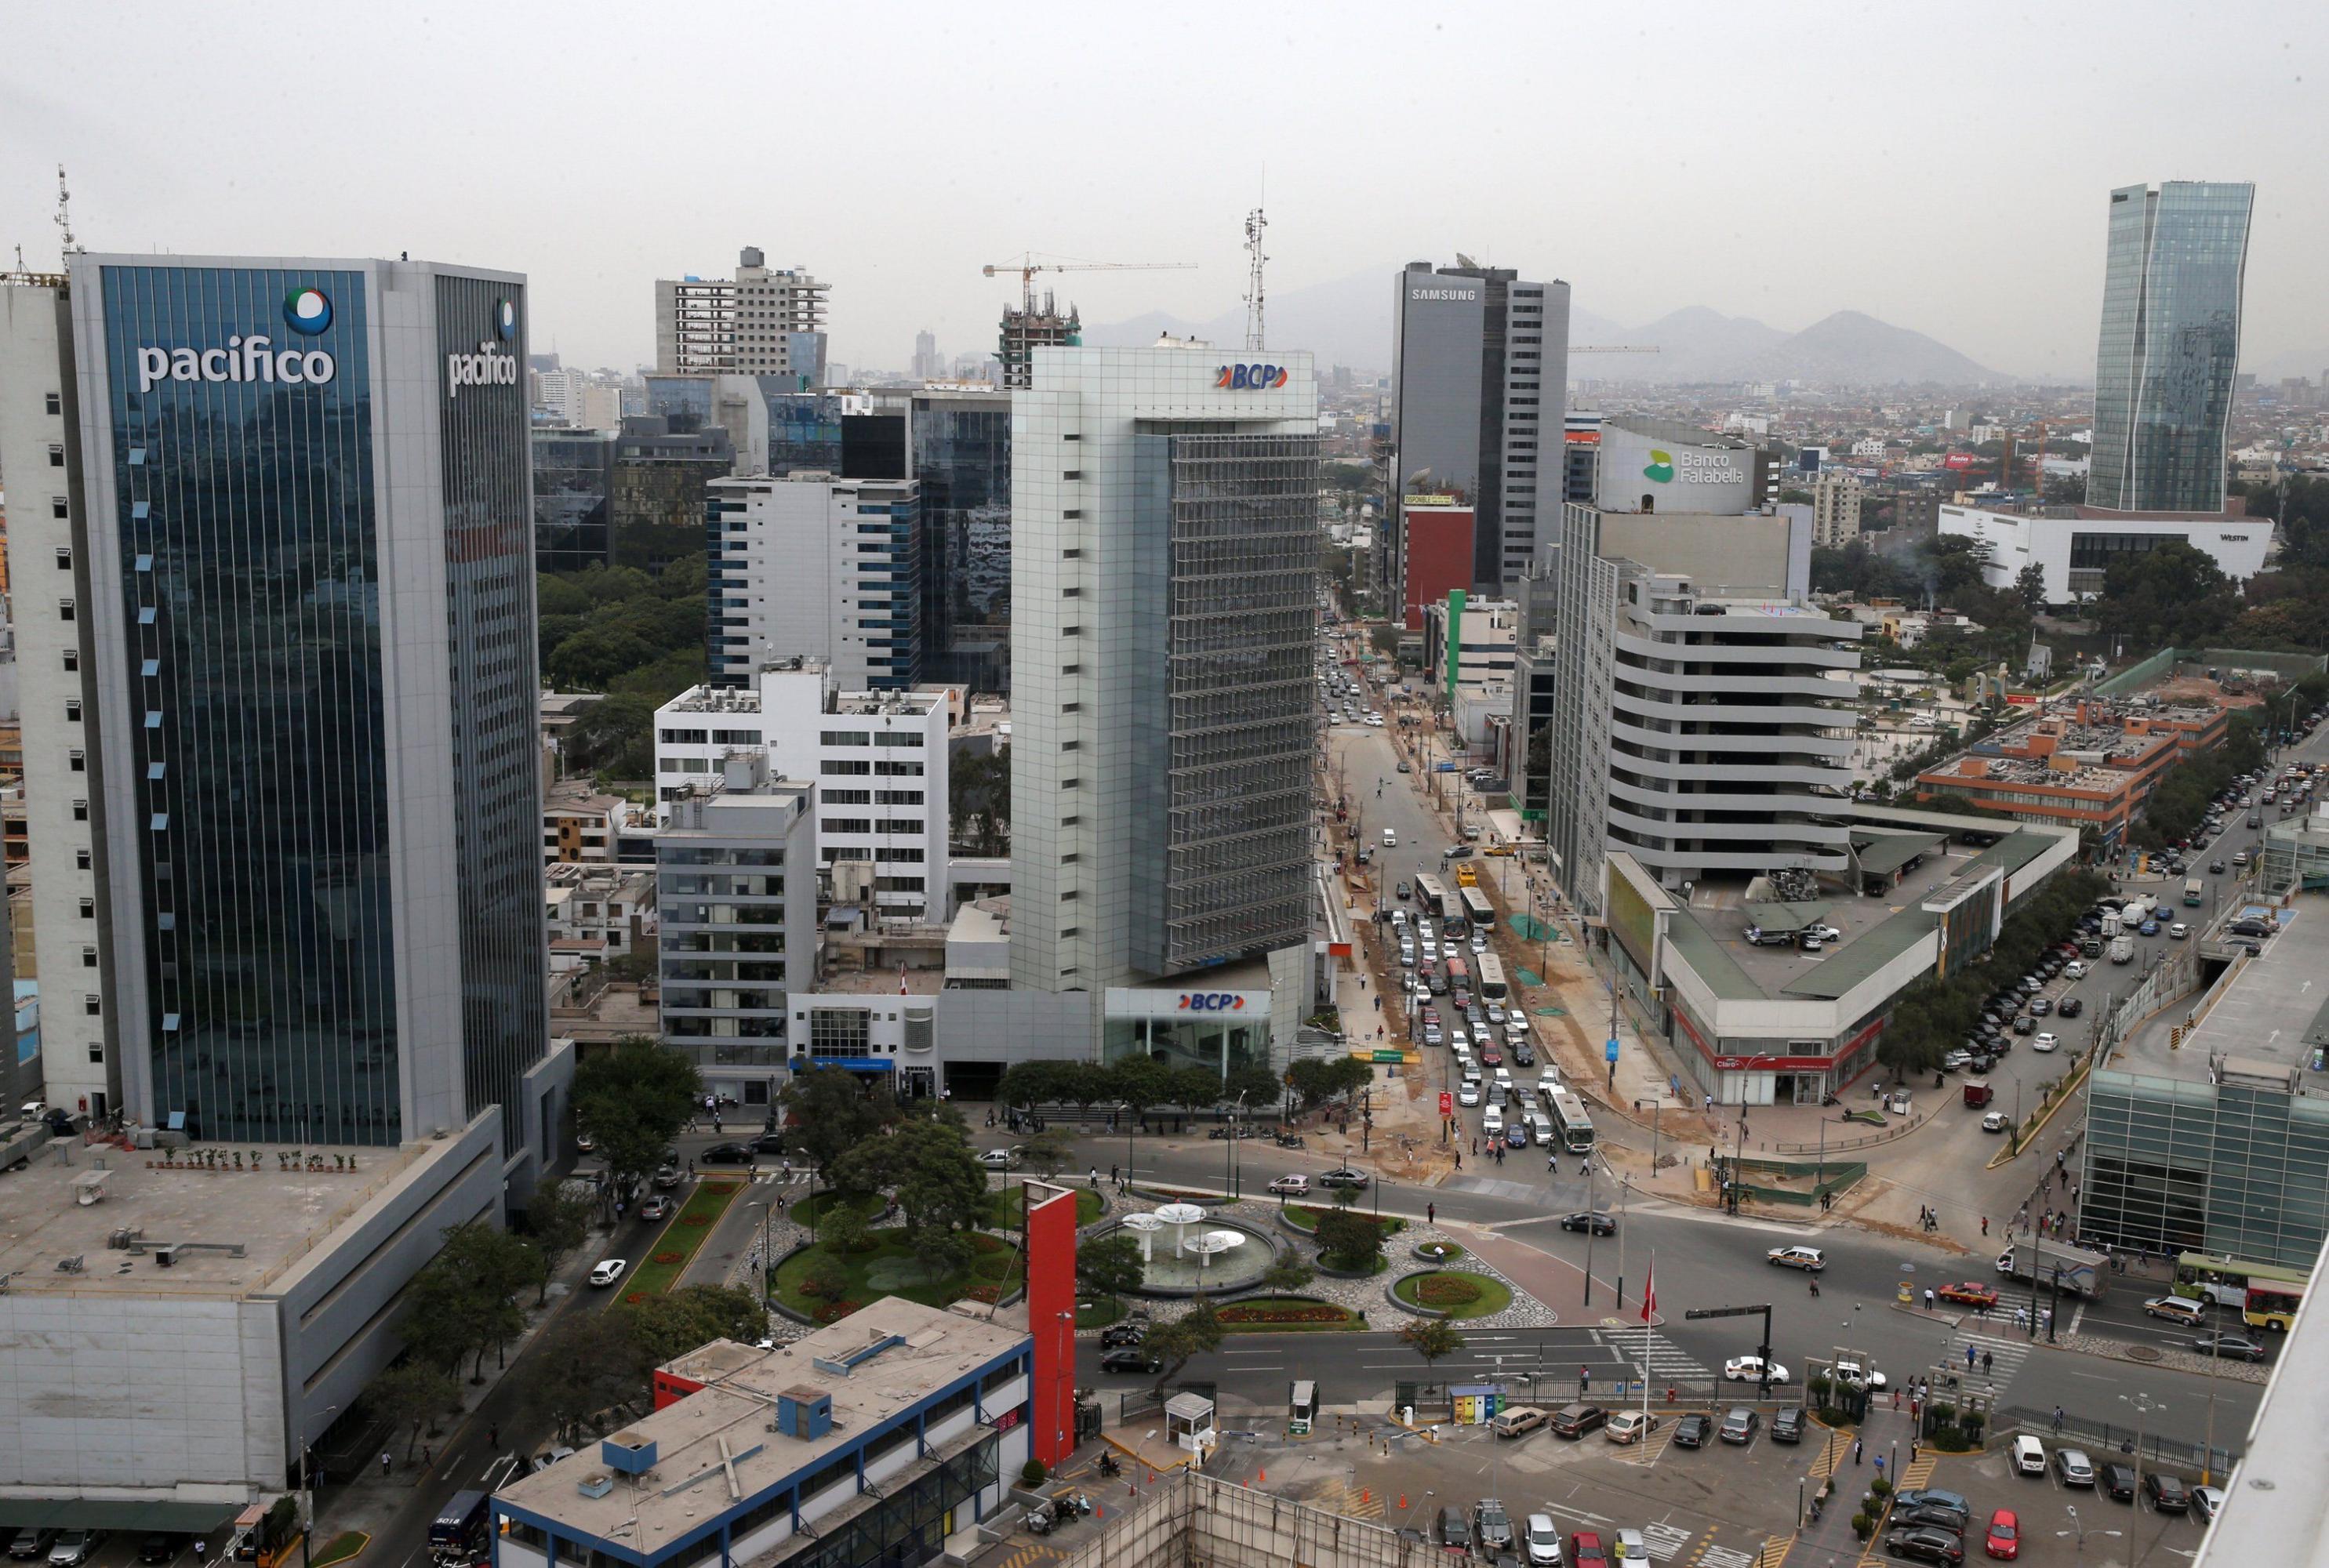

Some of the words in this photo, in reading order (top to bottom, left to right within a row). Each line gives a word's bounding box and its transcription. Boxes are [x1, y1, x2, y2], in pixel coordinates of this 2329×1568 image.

[1412, 289, 1475, 300] SAMSUNG
[137, 335, 335, 393] pacifico
[449, 341, 517, 397] pacifico
[1232, 364, 1277, 389] BCP
[1680, 452, 1729, 467] Banco
[1680, 468, 1743, 483] Falabella
[1190, 993, 1233, 1011] BCP
